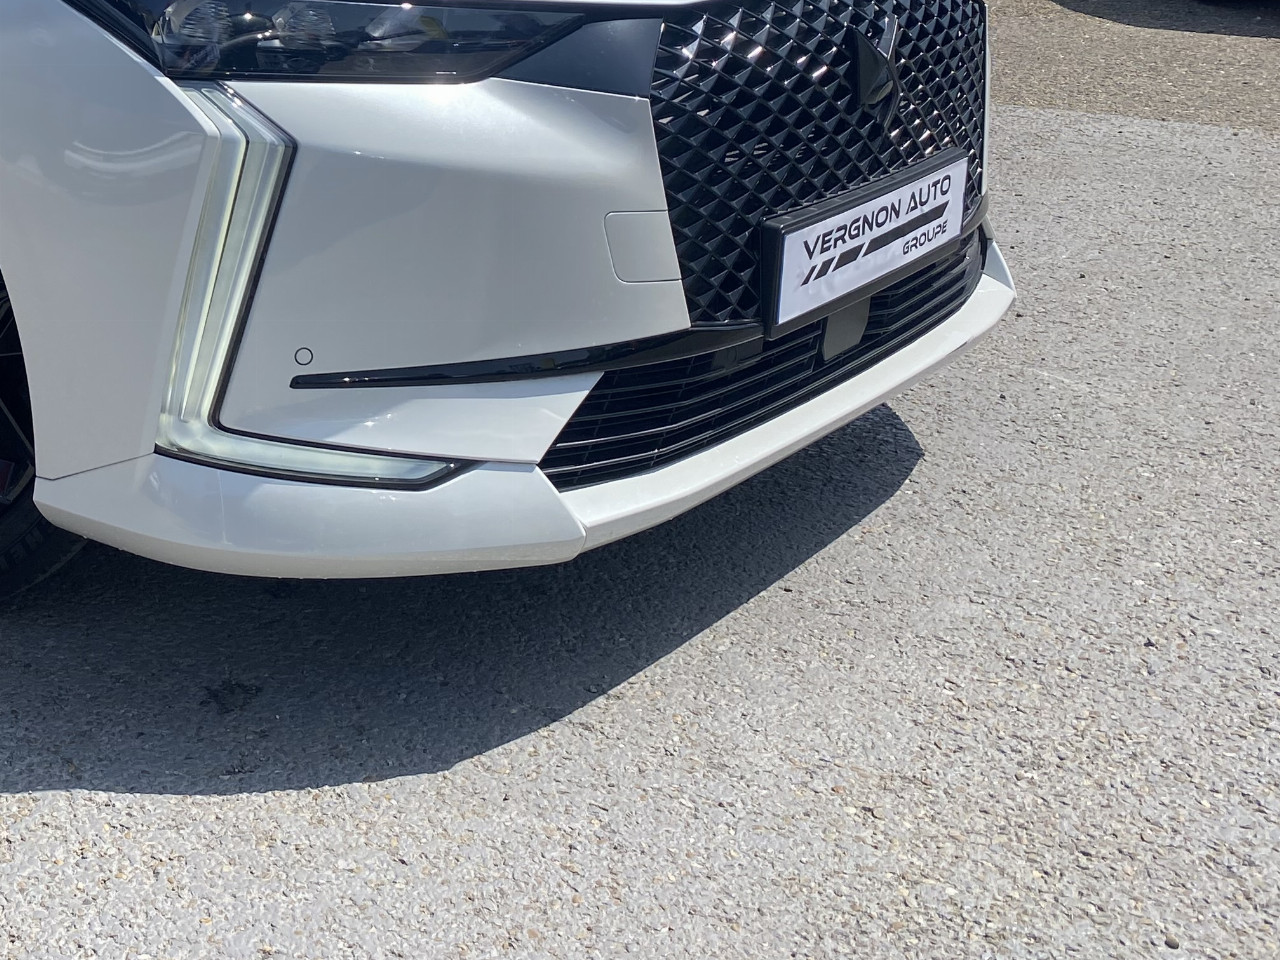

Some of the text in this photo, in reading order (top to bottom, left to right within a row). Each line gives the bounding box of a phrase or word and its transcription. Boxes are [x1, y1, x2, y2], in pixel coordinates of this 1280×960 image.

[803, 174, 952, 261] VERGNON AUTO
[902, 219, 949, 255] GROUPE
